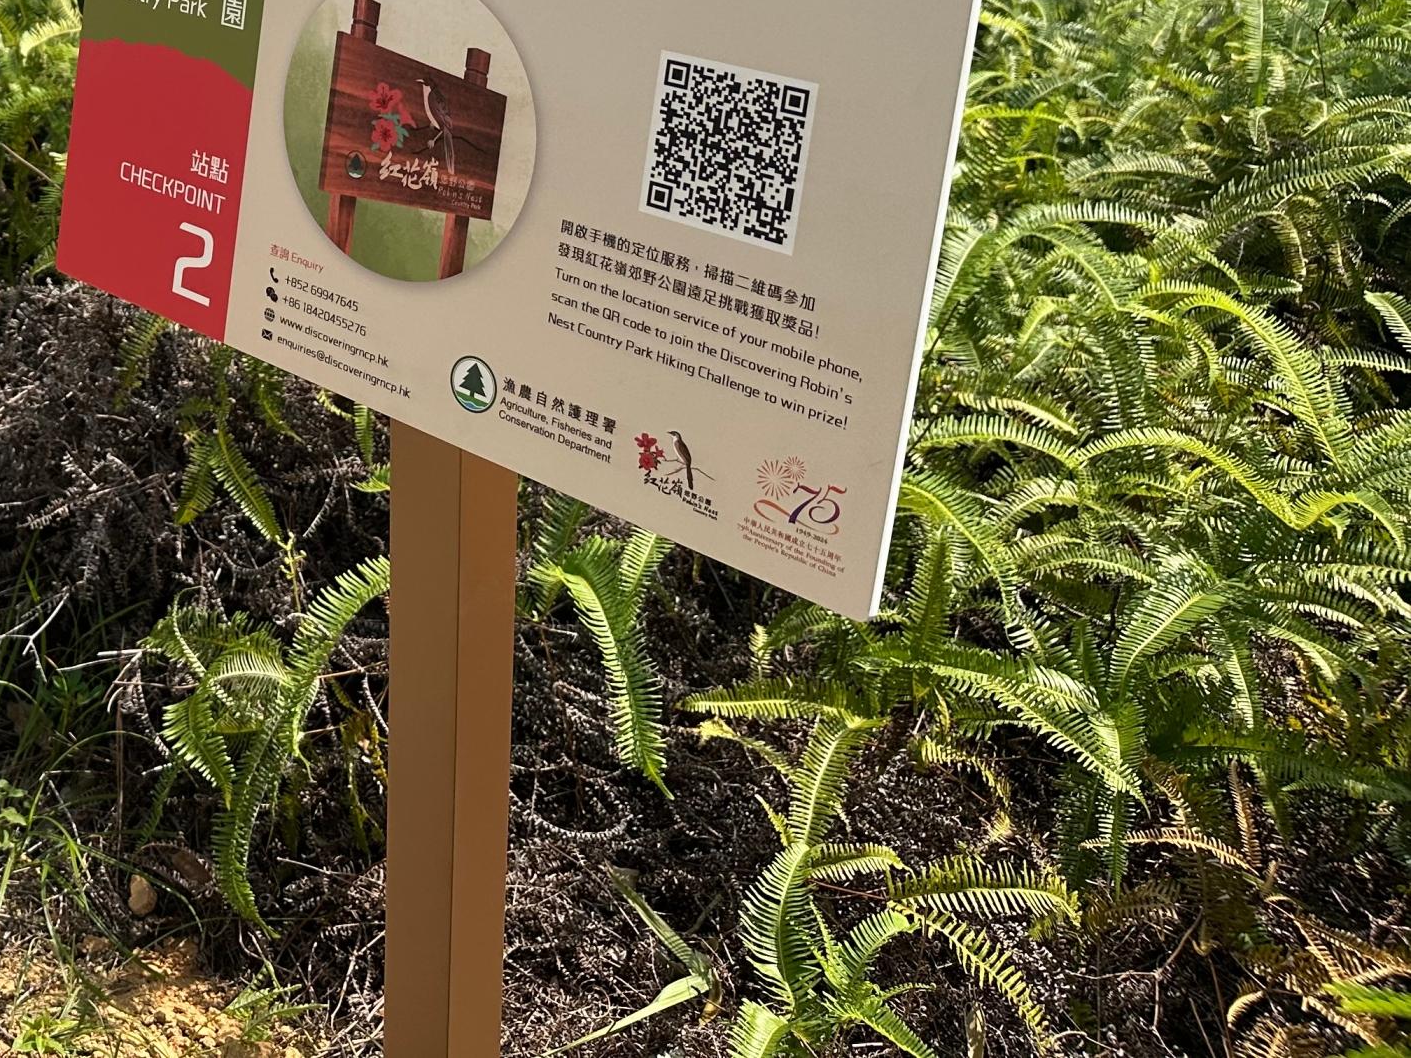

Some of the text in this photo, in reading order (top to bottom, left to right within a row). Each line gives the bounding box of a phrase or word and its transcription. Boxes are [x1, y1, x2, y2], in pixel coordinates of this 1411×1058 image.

[120, 161, 226, 214] CHECKPOINT
[190, 149, 229, 184] 站點
[379, 150, 439, 190] 紅花嶺
[172, 222, 214, 307] 2
[270, 244, 324, 273] 查詢 Enquiry
[282, 295, 366, 337] +86 18420455276
[285, 276, 359, 312] +852 69947645
[280, 315, 389, 368] www.discoveringrncp.hk
[551, 292, 853, 405] scan the QR code to join the Discovering Robin's
[555, 267, 862, 383] Turn on the location service of your mobile phone,
[277, 335, 411, 399] enquiries@discoveringrncp.hk
[548, 312, 848, 430] Nest Country Park Hiking Challenge to win prize!
[500, 396, 613, 450] Agriculture, Fisheries and
[502, 376, 617, 435] 漁農自然護理署
[498, 410, 611, 463] Conservation Department
[788, 482, 847, 524] 75
[754, 538, 778, 554] People's
[781, 549, 807, 565] Republic
[817, 565, 836, 577] China
[796, 527, 828, 544] 1949-2024
[806, 553, 836, 571] Founding
